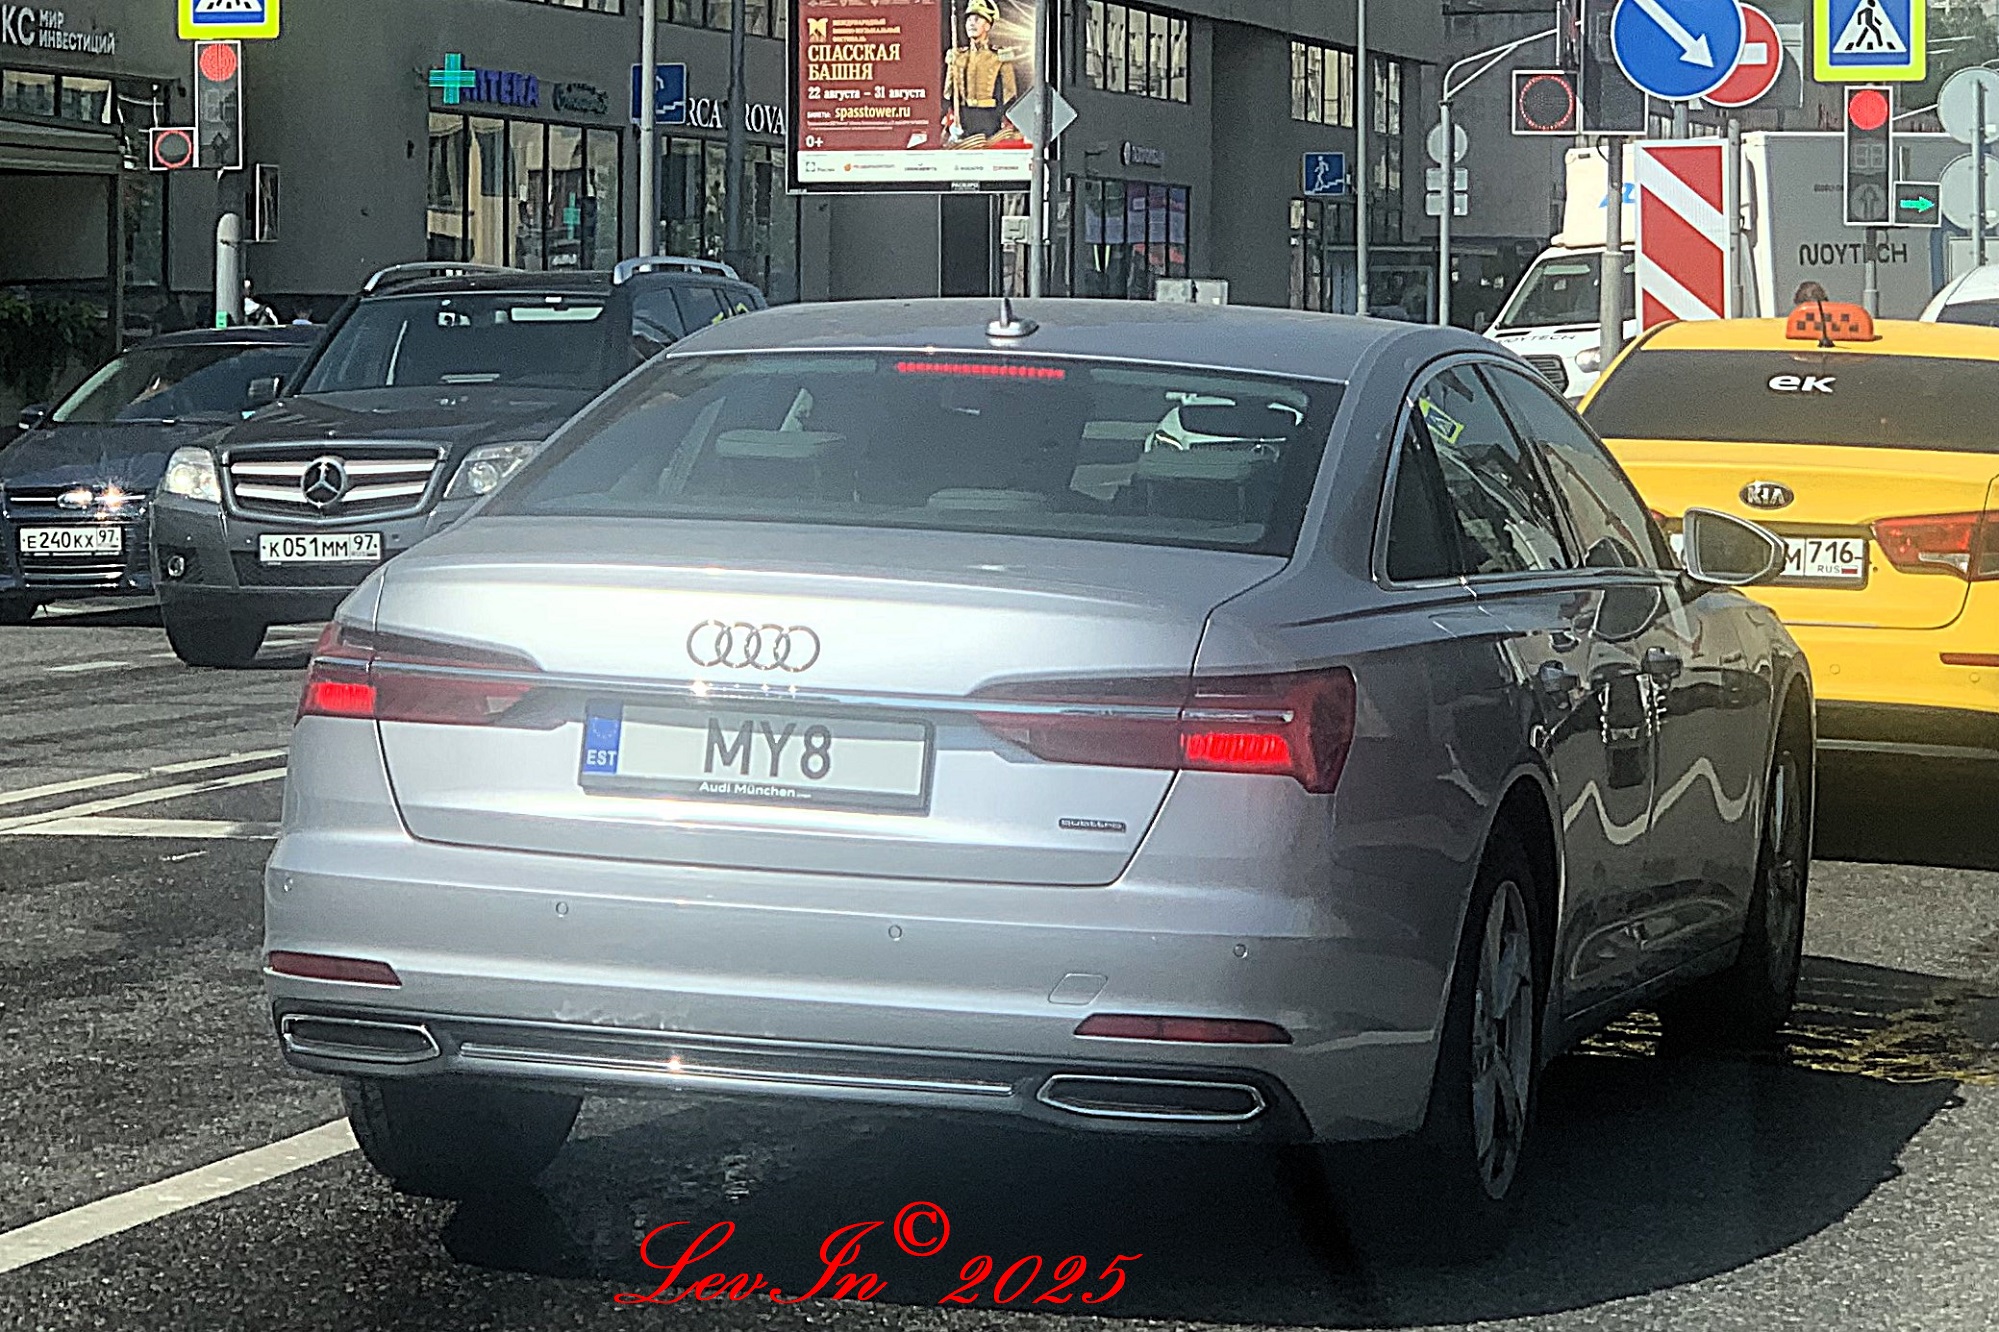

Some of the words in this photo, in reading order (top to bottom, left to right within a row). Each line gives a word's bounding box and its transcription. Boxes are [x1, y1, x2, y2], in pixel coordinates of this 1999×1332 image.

[39, 9, 64, 29] МИР
[39, 29, 115, 55] ИНВЕСТИЦИЙ
[807, 43, 901, 62] СПАССКАЯ
[808, 63, 873, 81] БАШНЯ
[808, 86, 821, 99] 22
[823, 89, 860, 101] августа
[874, 85, 886, 98] 31
[889, 88, 926, 100] августа
[835, 105, 911, 120] spasstower.ru
[805, 135, 824, 148] 0+
[1799, 243, 1908, 266] NOYTCH
[1747, 486, 1785, 505] KIA
[98, 529, 115, 543] 97
[353, 534, 374, 551] 97
[1809, 541, 1854, 563] 716
[1817, 564, 1841, 575] RUS
[704, 716, 832, 780] MY8
[586, 749, 617, 766] EST
[699, 781, 730, 794] Audi
[734, 784, 796, 798] München
